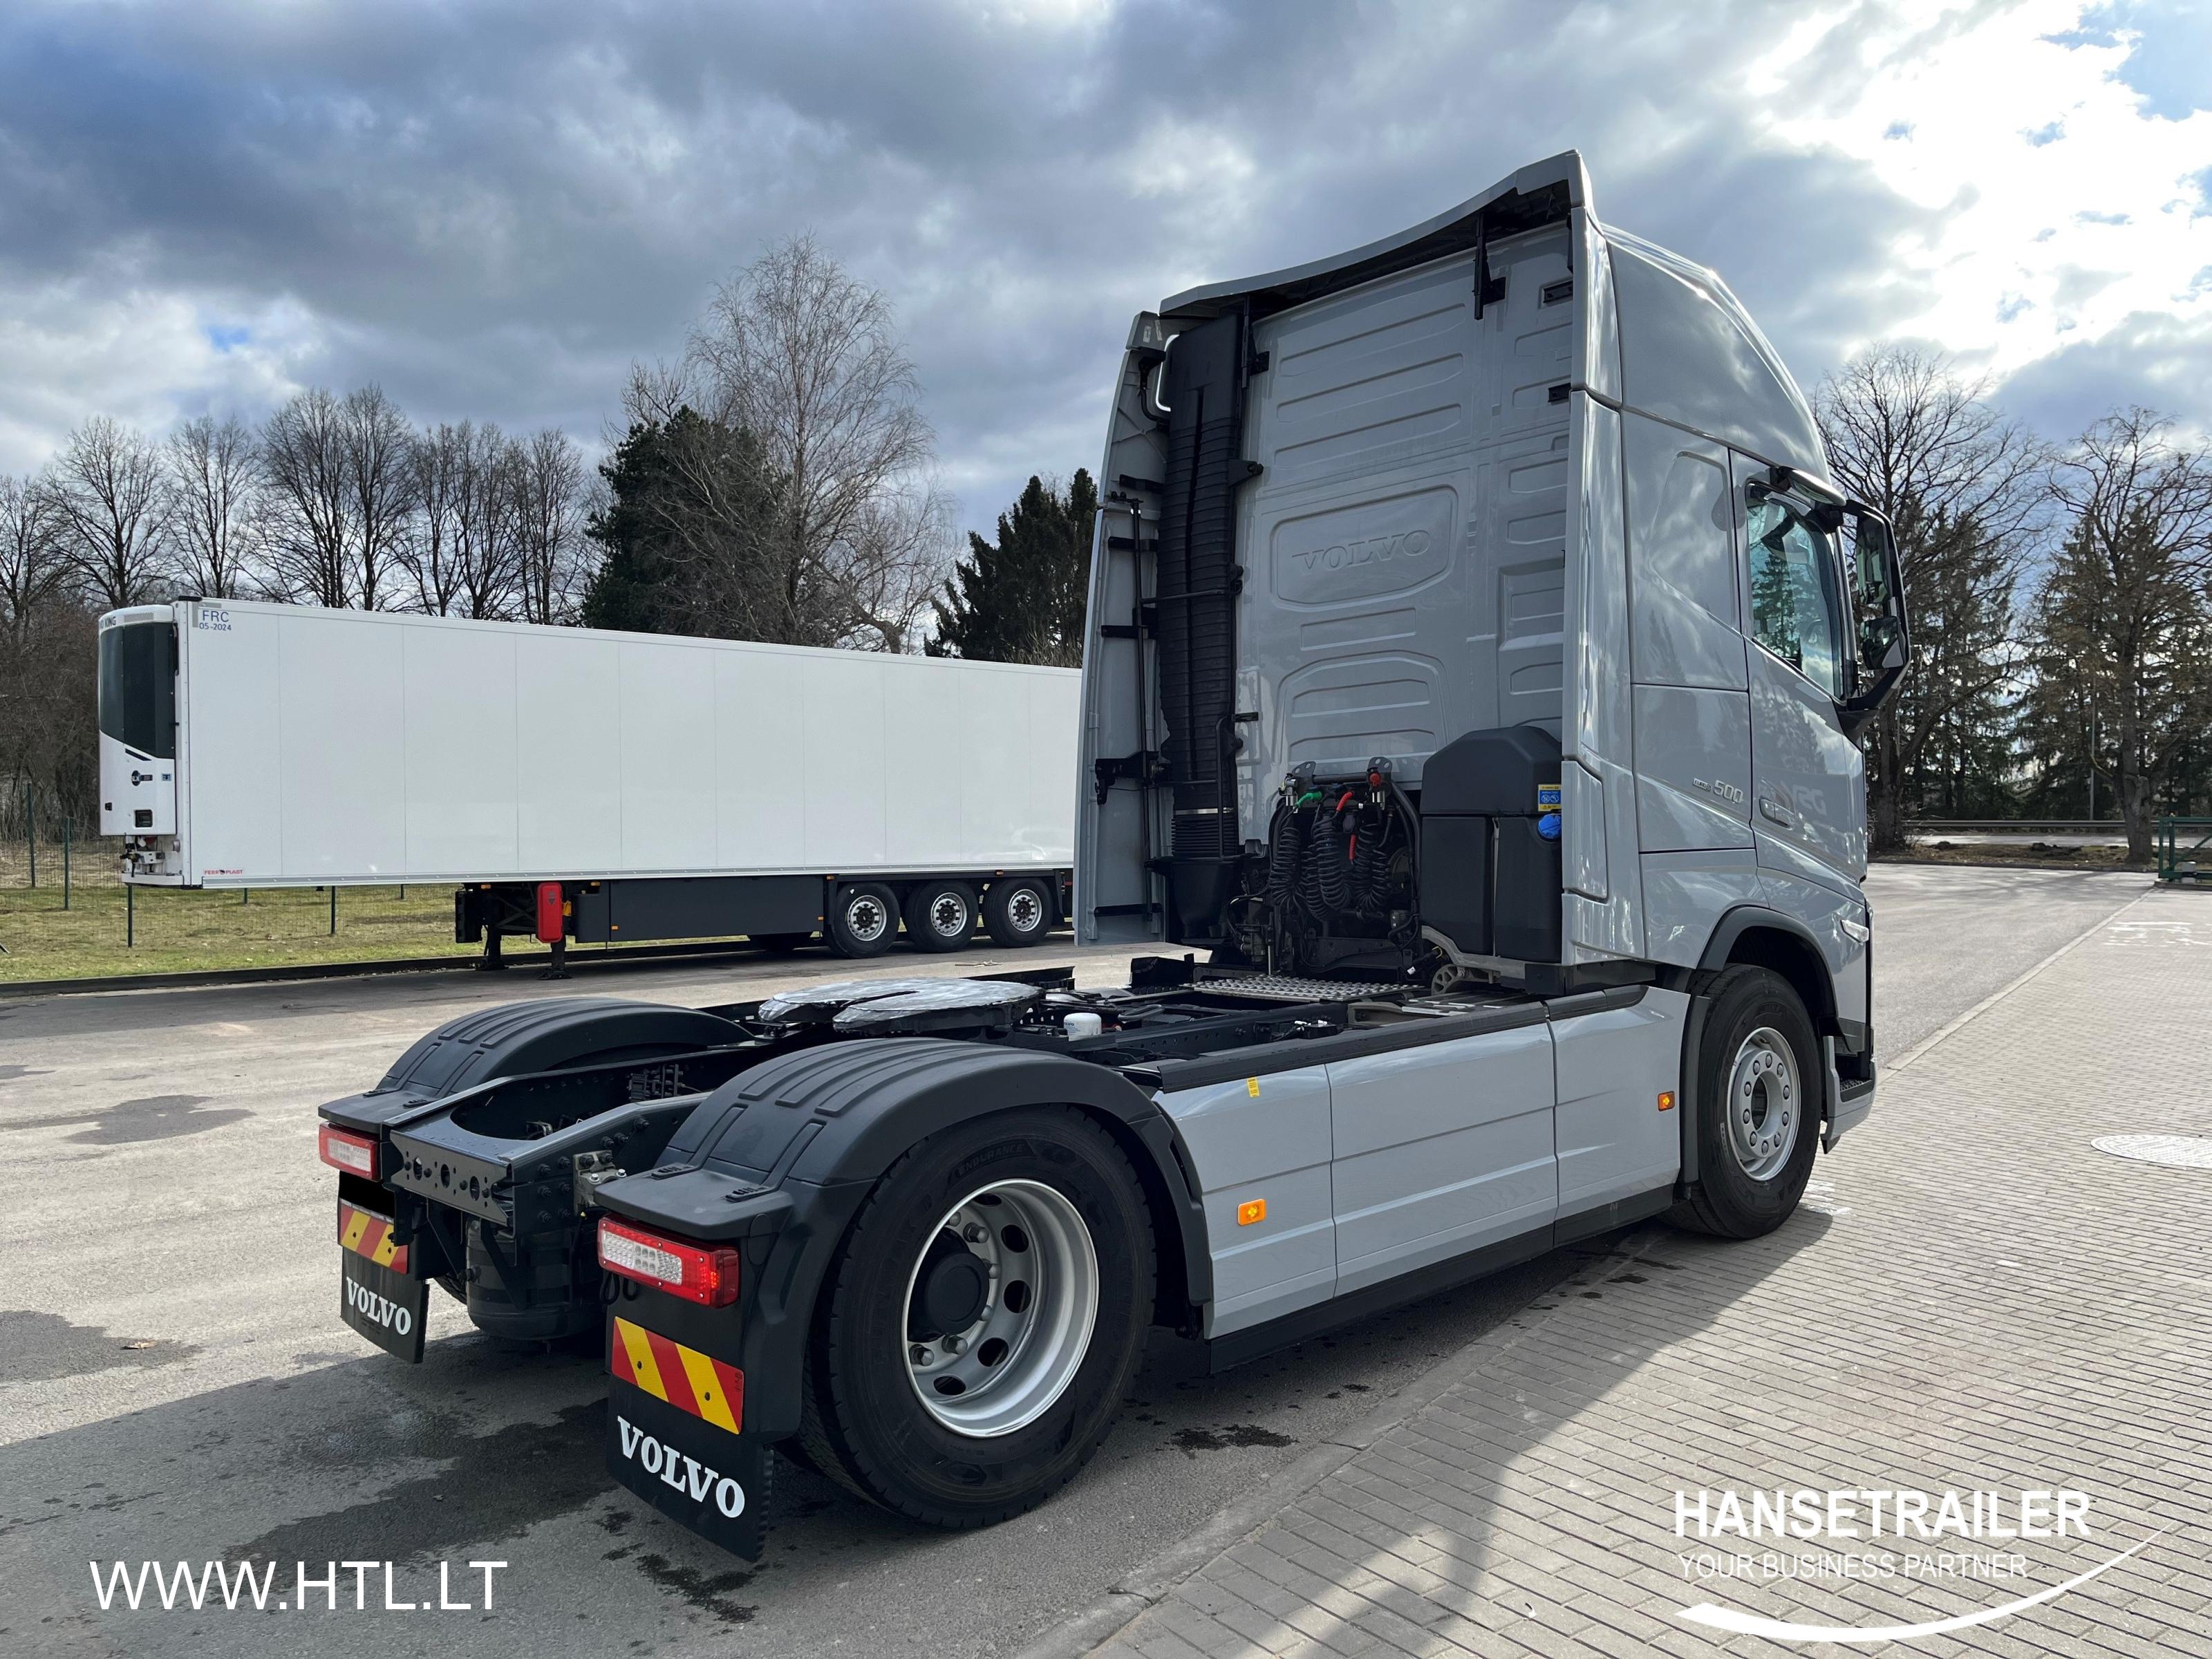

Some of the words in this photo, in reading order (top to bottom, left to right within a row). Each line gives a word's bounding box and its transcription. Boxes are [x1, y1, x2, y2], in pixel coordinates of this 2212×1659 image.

[1291, 529, 1431, 575] VOLVO
[202, 610, 229, 622] FRC
[1714, 780, 1743, 803] 500
[957, 1143, 1024, 1176] ENDURANCE
[346, 1276, 411, 1335] VOLVO
[617, 1415, 745, 1518] VOLVO
